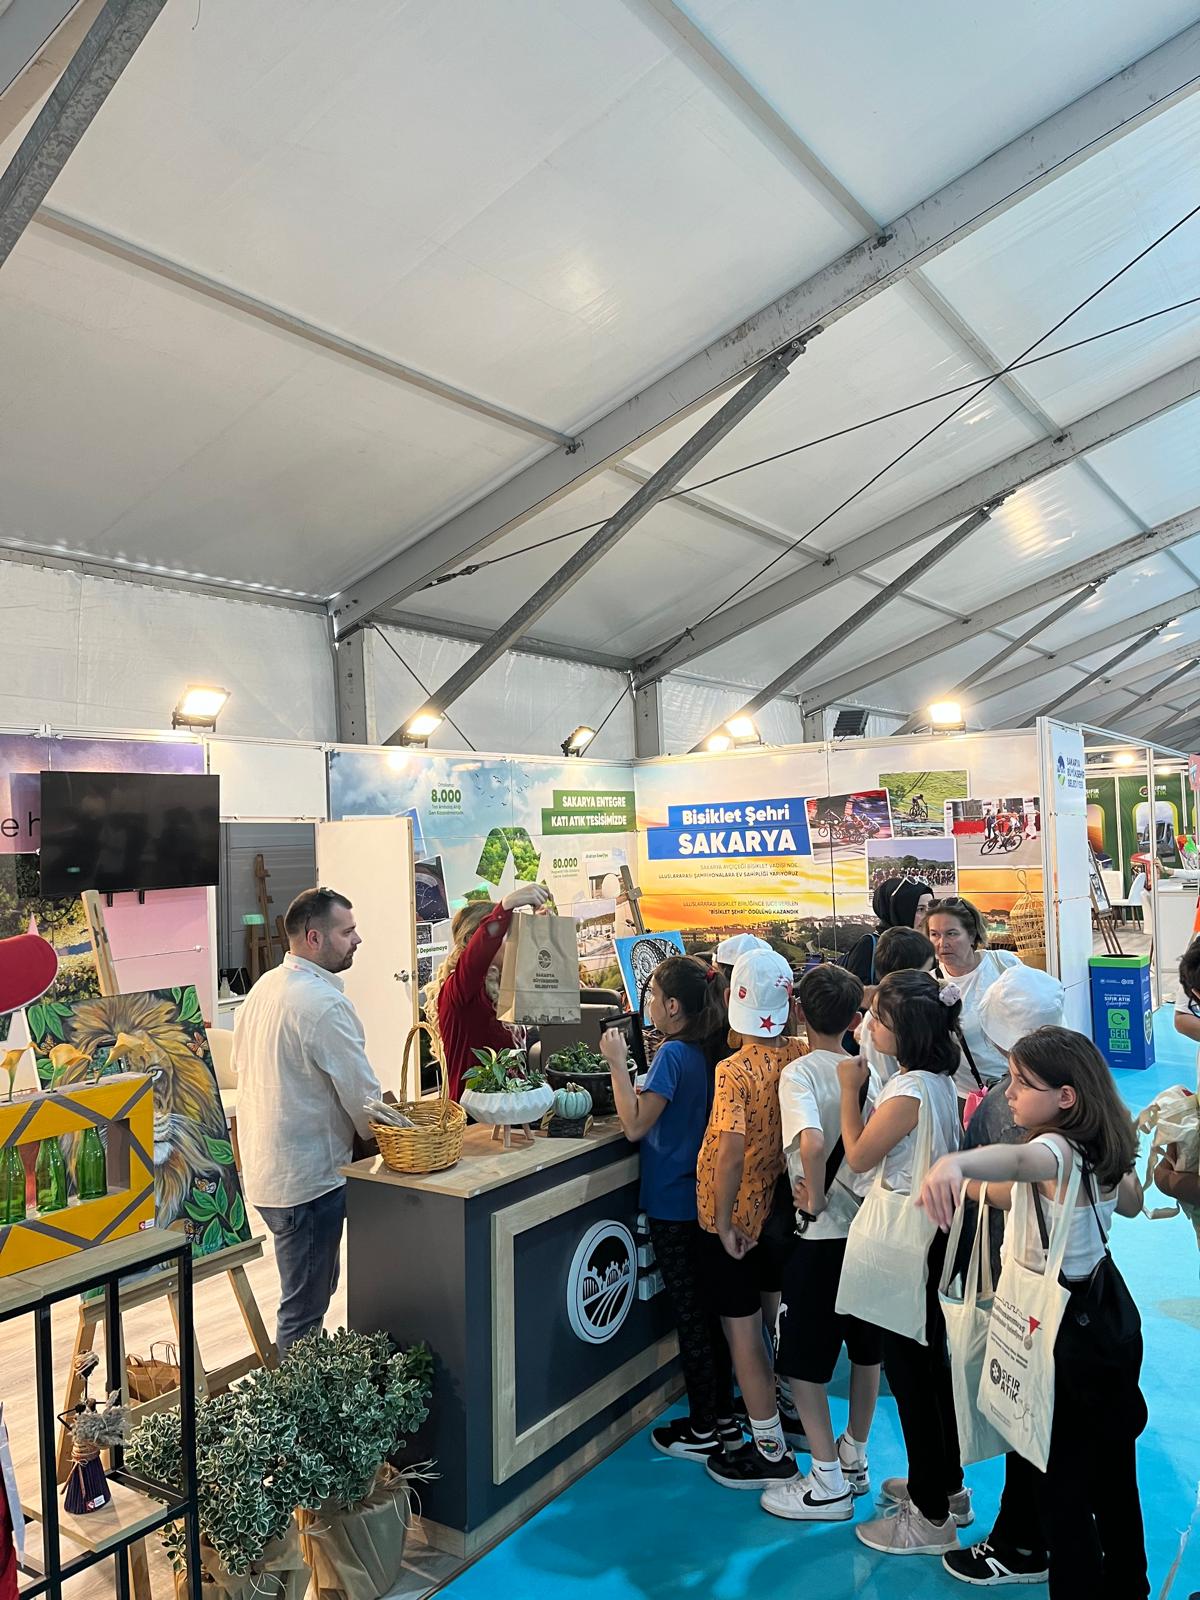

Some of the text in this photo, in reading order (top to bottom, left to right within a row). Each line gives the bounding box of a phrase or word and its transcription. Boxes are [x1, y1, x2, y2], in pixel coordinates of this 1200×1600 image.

[431, 789, 462, 803] 8.000
[562, 795, 626, 808] SAKARYA ENTEGRE
[551, 812, 627, 827] KATI ATIK TESİSİMİZDE
[682, 804, 790, 826] Bisiklet Şehri
[678, 829, 797, 855] SAKARYA
[552, 857, 578, 869] 80.000
[1000, 1381, 1019, 1404] ATIK
